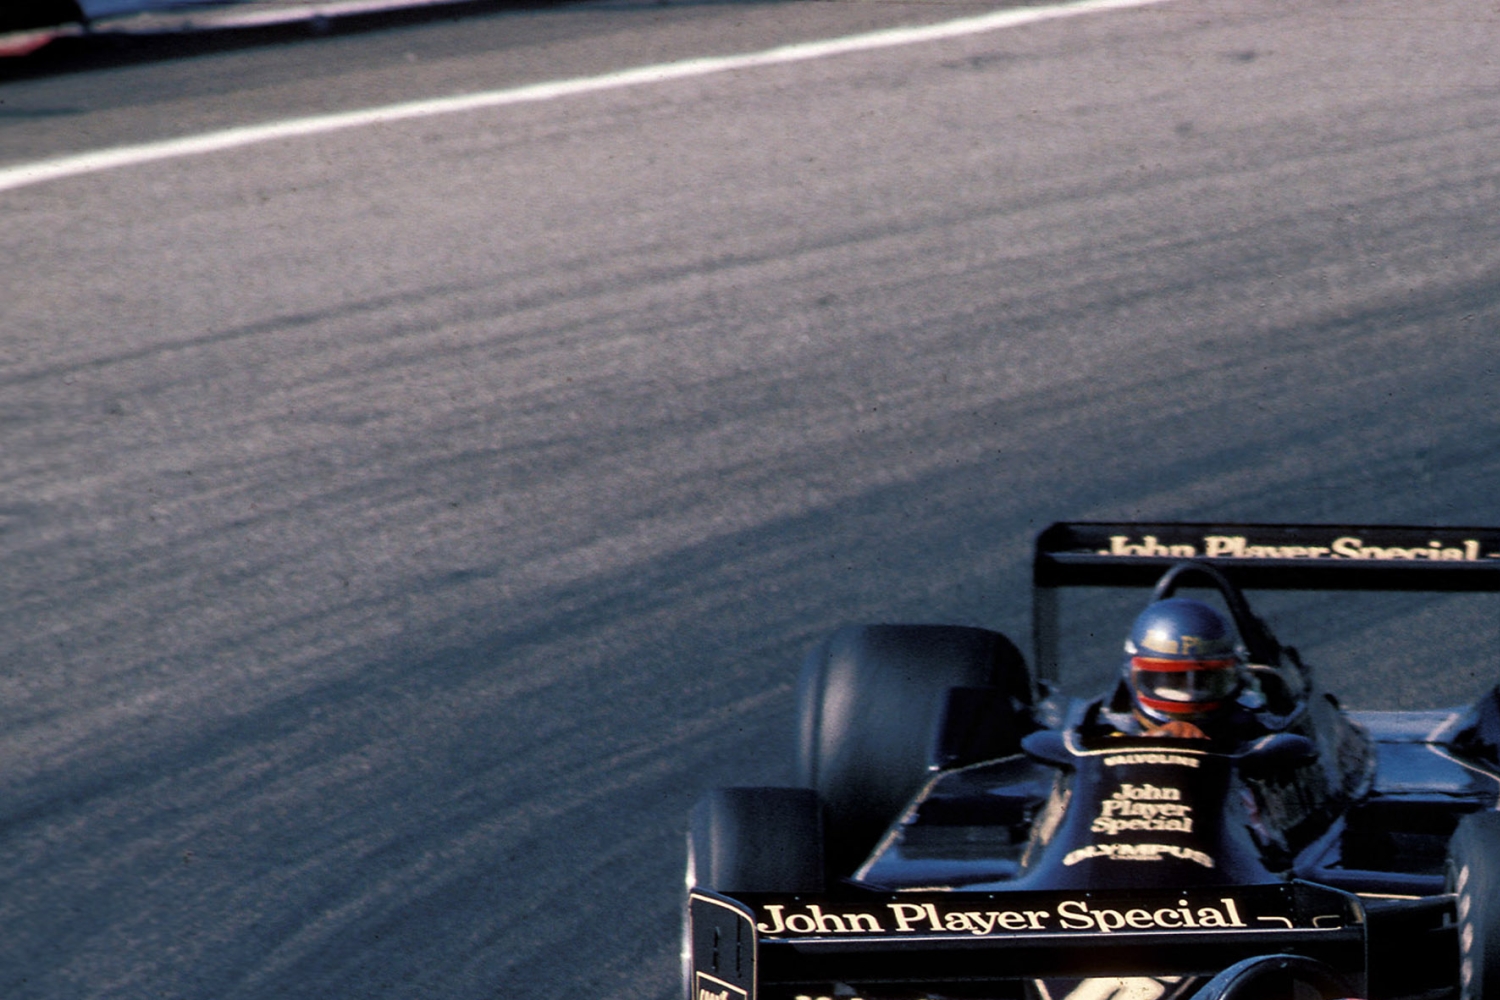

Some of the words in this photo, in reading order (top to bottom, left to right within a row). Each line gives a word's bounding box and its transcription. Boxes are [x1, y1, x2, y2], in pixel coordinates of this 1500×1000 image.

[1099, 536, 1196, 557] John
[1330, 538, 1481, 562] Special
[1112, 783, 1181, 801] John
[1101, 799, 1192, 820] Player
[1090, 815, 1193, 835] Special
[757, 904, 886, 934] John
[887, 903, 1050, 935] Player
[1057, 898, 1248, 933] Special
